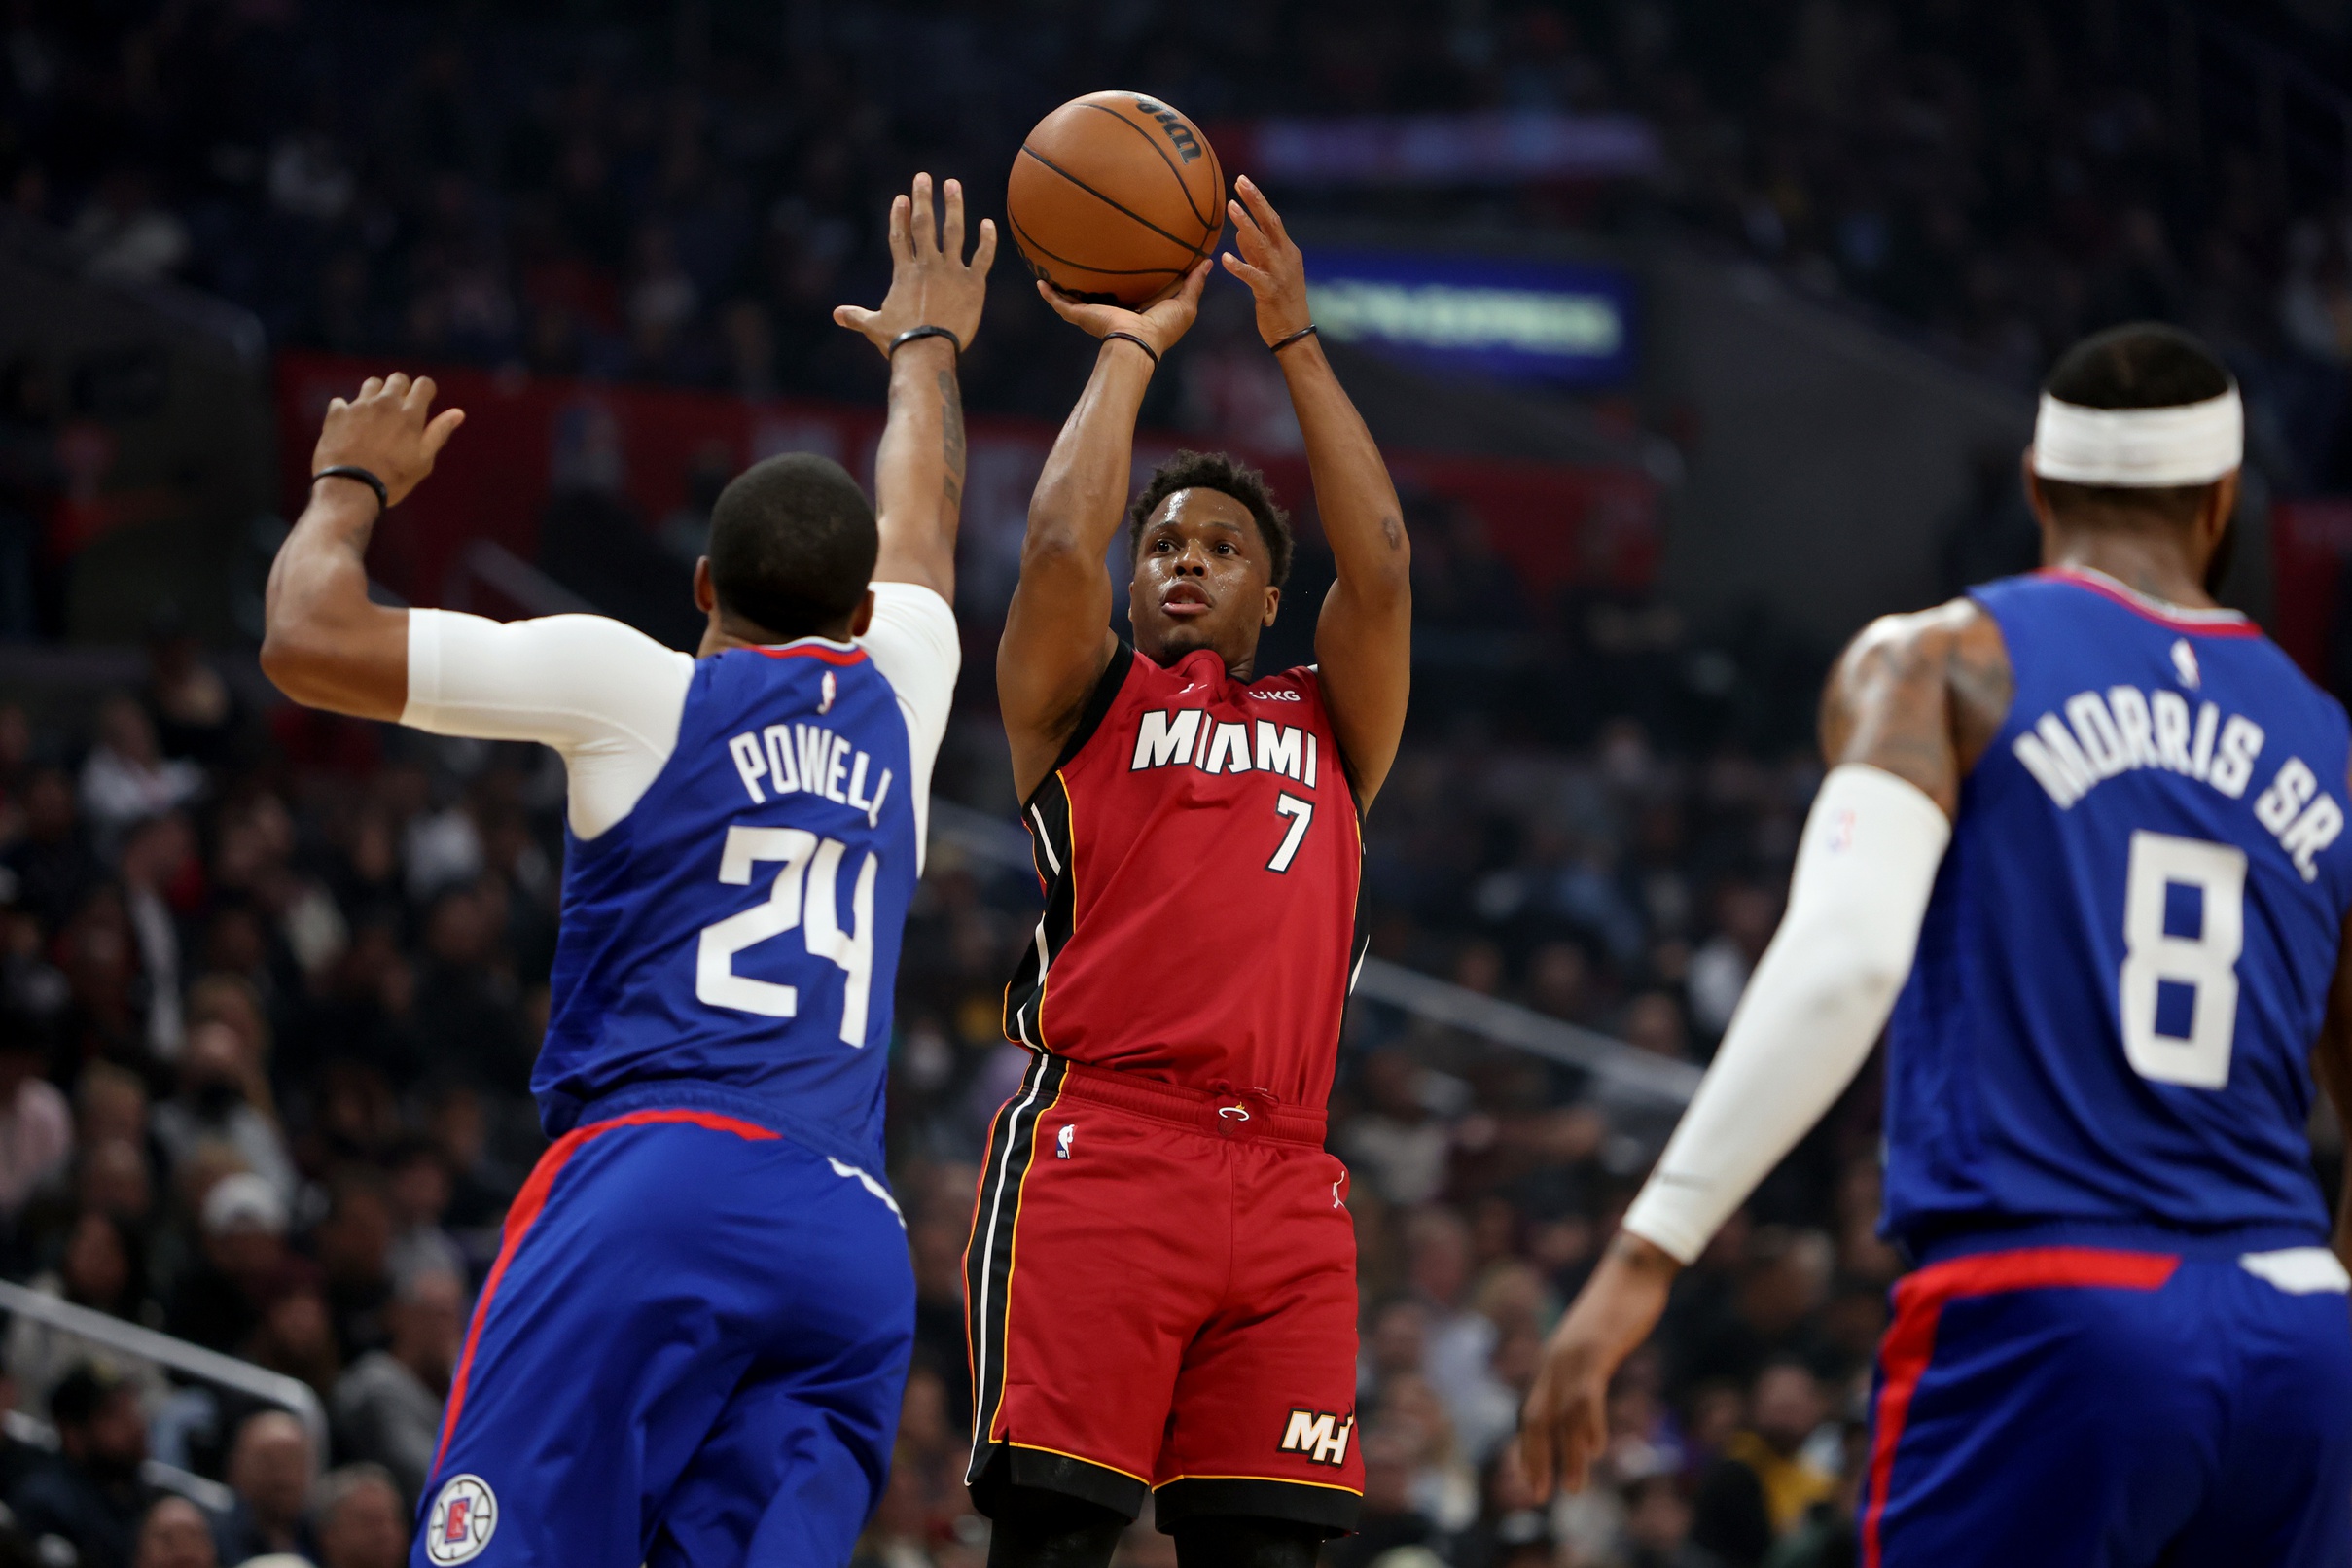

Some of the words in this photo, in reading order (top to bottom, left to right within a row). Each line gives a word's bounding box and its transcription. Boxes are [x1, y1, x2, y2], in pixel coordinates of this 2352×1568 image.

[1136, 101, 1201, 165] Wil
[1129, 708, 1317, 790] MIAMI
[2013, 685, 2264, 810] MORRIS
[2253, 756, 2343, 883] SR.
[1265, 790, 1315, 874] 7
[695, 825, 876, 1049] 24
[2120, 829, 2248, 1091] 8
